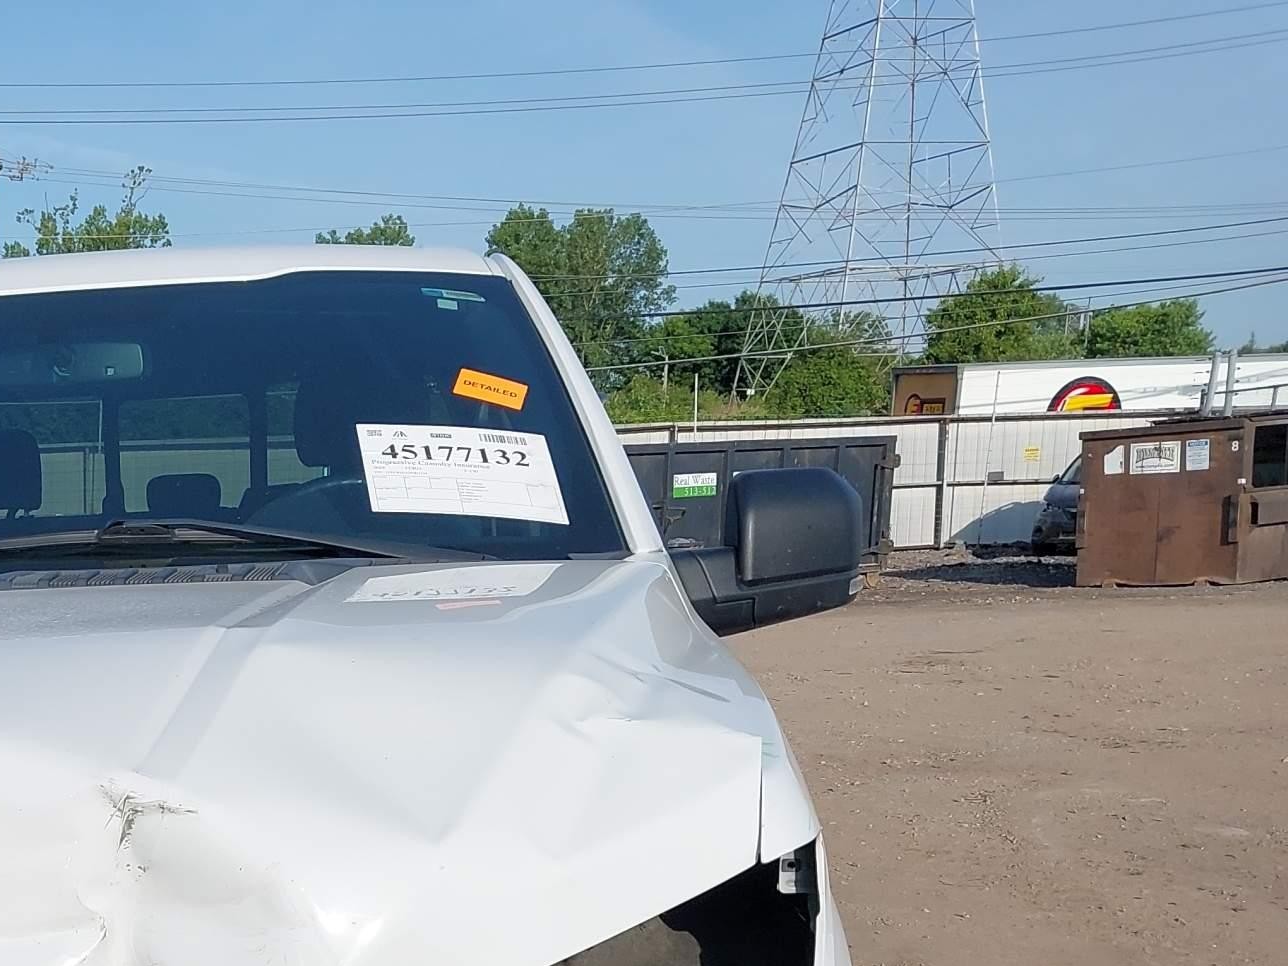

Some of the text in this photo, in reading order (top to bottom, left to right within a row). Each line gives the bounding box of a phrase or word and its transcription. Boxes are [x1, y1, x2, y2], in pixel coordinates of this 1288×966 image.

[463, 379, 518, 398] DETAILED
[1231, 440, 1240, 452] 8
[381, 443, 530, 468] 45177132
[674, 474, 715, 487] Real Waste
